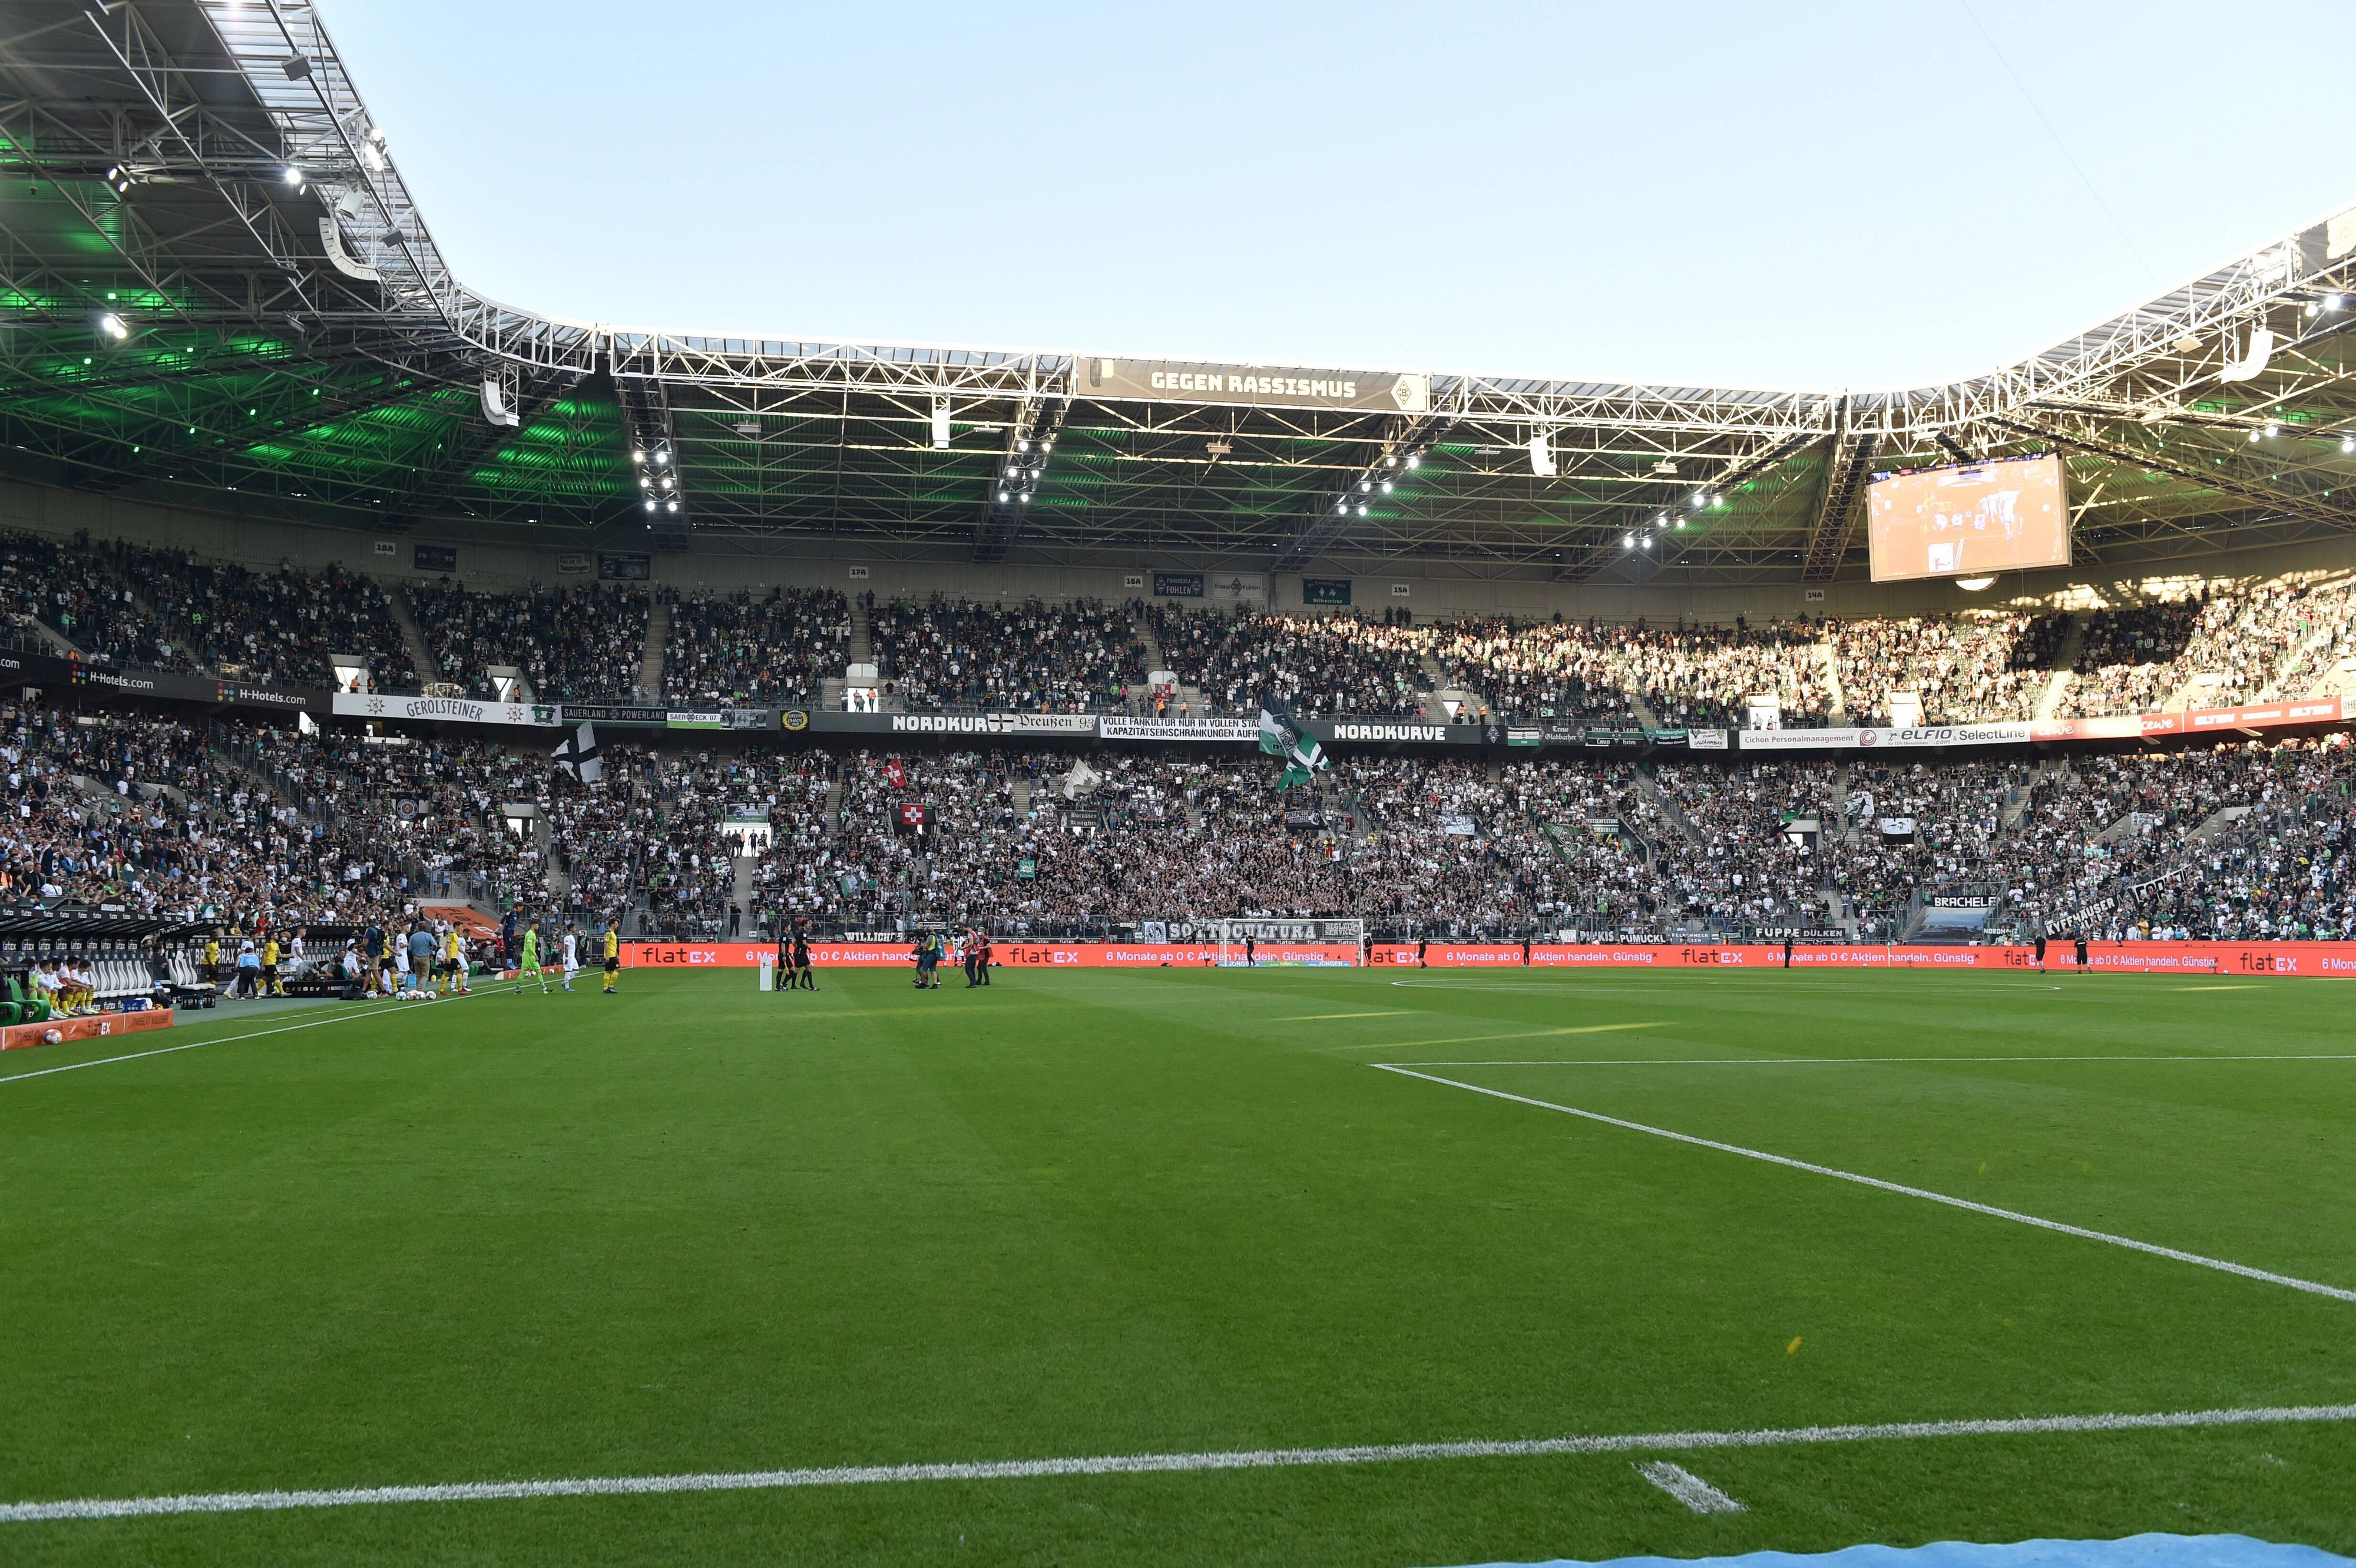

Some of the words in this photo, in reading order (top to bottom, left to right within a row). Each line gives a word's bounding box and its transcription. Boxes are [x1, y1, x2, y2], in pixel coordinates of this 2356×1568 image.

[1151, 372, 1223, 392] GEGEN
[1228, 375, 1356, 399] RASSISMUS
[376, 544, 393, 553] 18A
[90, 671, 154, 689] H-Hotels.com
[240, 689, 306, 705] H-Hotels.com
[406, 699, 483, 721] GEROLSTEINER
[564, 708, 606, 718] SAUERLAND
[622, 710, 665, 719] POWERLAND
[892, 716, 1012, 732] NORDKUR
[1015, 714, 1071, 729] Preußen
[1103, 717, 1127, 726] VOLLE
[1130, 717, 1176, 727] FANKULTUR
[1179, 719, 1195, 727] NUR
[1199, 719, 1206, 727] IN
[1210, 719, 1239, 727] VOLLEN
[2140, 718, 2174, 730] cewe
[1107, 726, 1234, 738] KAPAZITÄTSEINSCHRÄNKUNGEN
[1334, 725, 1445, 740] NORDKURVE
[1959, 728, 2025, 740] SelectLine
[1772, 735, 1854, 745] Personalmanagement
[1285, 810, 1312, 819] DROPKICK
[1169, 923, 1316, 938] SOTTOCULTURA
[1755, 928, 1800, 938] FUPPE
[1803, 929, 1843, 937] DÜLKEN
[844, 932, 890, 942] WILLICH
[1580, 931, 1614, 942] PINKIS
[1620, 934, 1666, 944] PUMUCKL
[746, 951, 753, 961] 6
[820, 951, 829, 961] 0
[831, 951, 839, 961] €
[841, 951, 872, 961] Aktien
[1106, 952, 1113, 961] 6
[1117, 952, 1157, 961] Monate
[1160, 951, 1173, 961] ab
[1176, 952, 1184, 961] 0
[1186, 952, 1194, 961] €
[1197, 952, 1231, 961] Aktien
[1447, 952, 1454, 961] 6
[1456, 952, 1495, 961] Monate
[1497, 951, 1510, 961] ab
[1513, 952, 1520, 961] 0
[1533, 952, 1565, 961] Aktien
[1567, 952, 1610, 961] handeln.
[1767, 952, 1774, 961] 6
[1815, 952, 1828, 961] ab
[1830, 952, 1838, 961] 0
[1840, 952, 1848, 961] €
[1851, 952, 1885, 962] Aktien
[1889, 952, 1931, 962] handeln.
[2060, 955, 2065, 964] 6
[2095, 955, 2104, 964] ab
[2106, 955, 2111, 964] 0
[2113, 955, 2119, 964] €
[2120, 955, 2145, 965] Aktien
[2146, 956, 2180, 966] handeln.
[2322, 958, 2329, 970] 6
